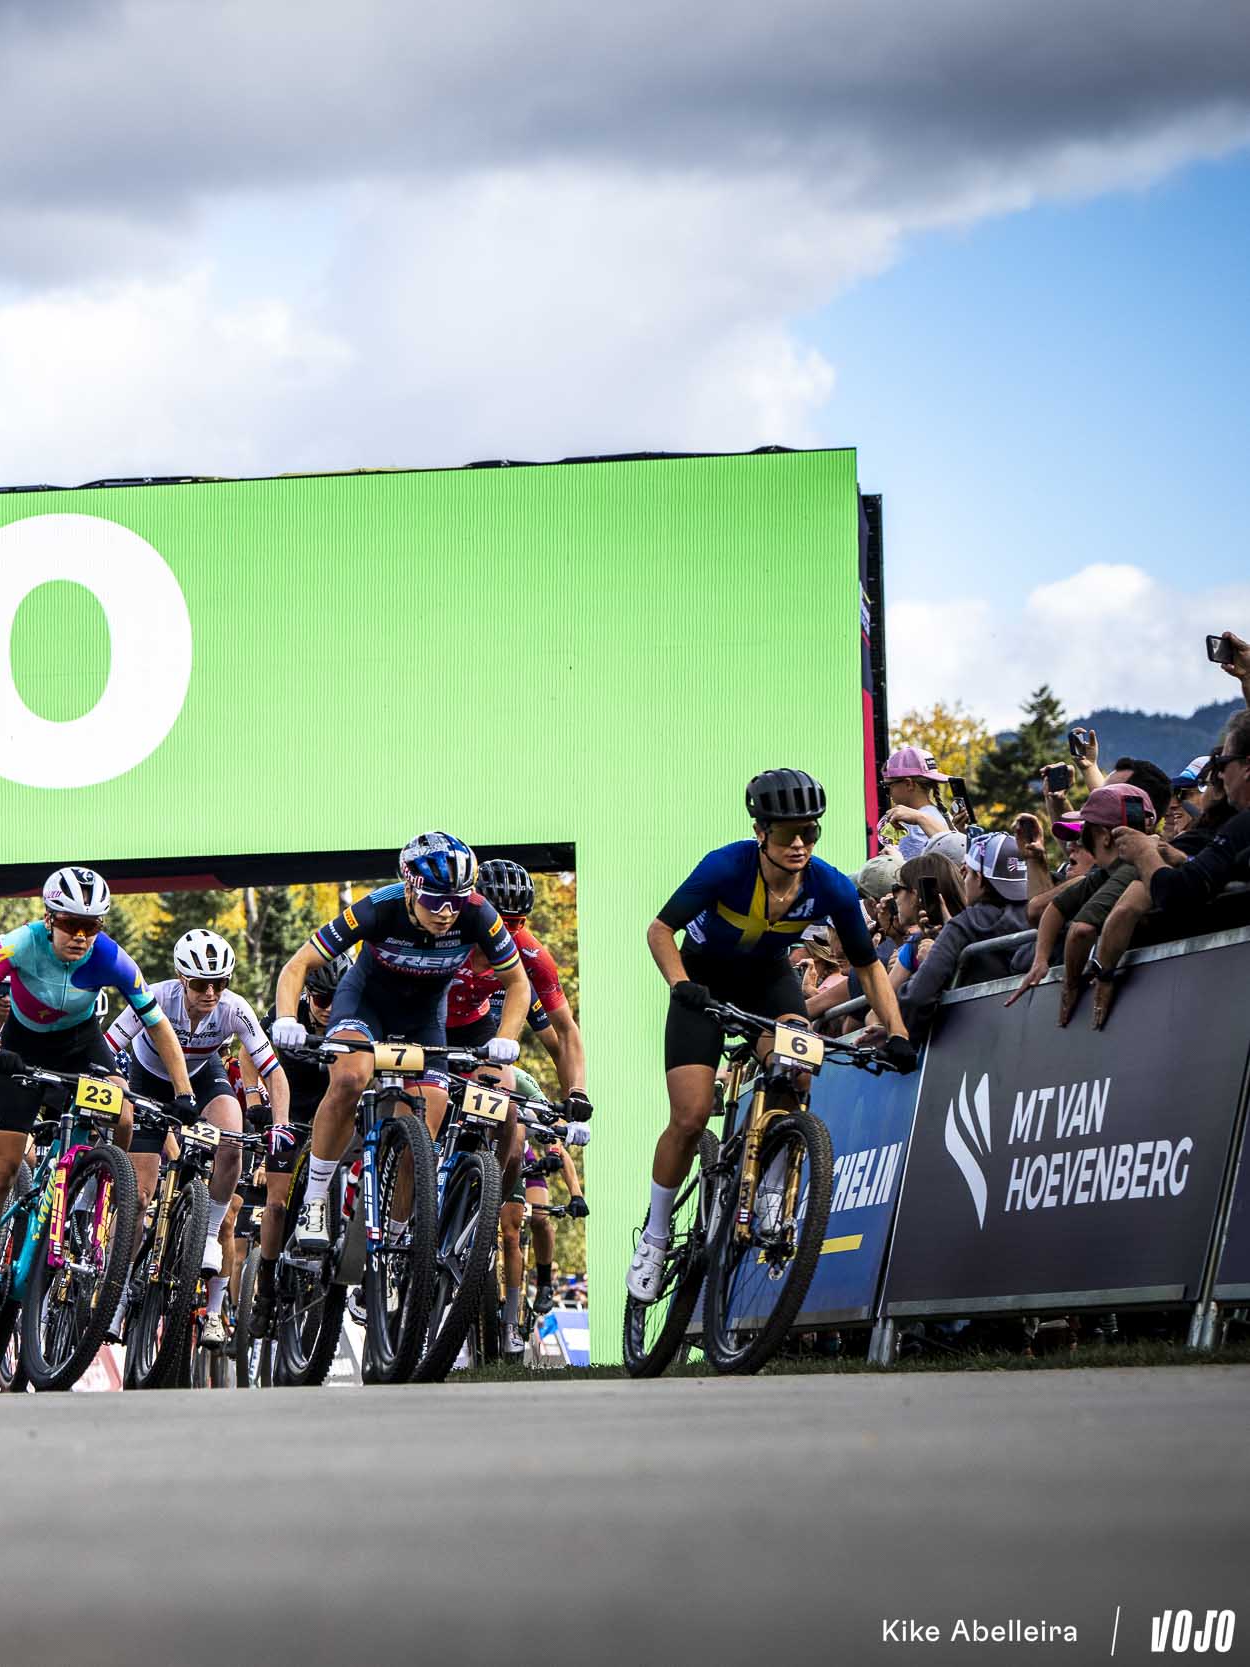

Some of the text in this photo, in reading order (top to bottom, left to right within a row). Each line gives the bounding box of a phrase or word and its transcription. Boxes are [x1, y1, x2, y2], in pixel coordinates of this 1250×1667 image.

[376, 947, 467, 968] TREK
[791, 1036, 808, 1055] 6
[391, 1048, 407, 1066] 7
[85, 1085, 112, 1106] 23
[473, 1093, 503, 1114] 17
[1008, 1078, 1111, 1145] MT VAN
[190, 1125, 216, 1141] 42
[798, 1142, 902, 1220] CHELIN
[1004, 1136, 1194, 1212] HOEVENBERG
